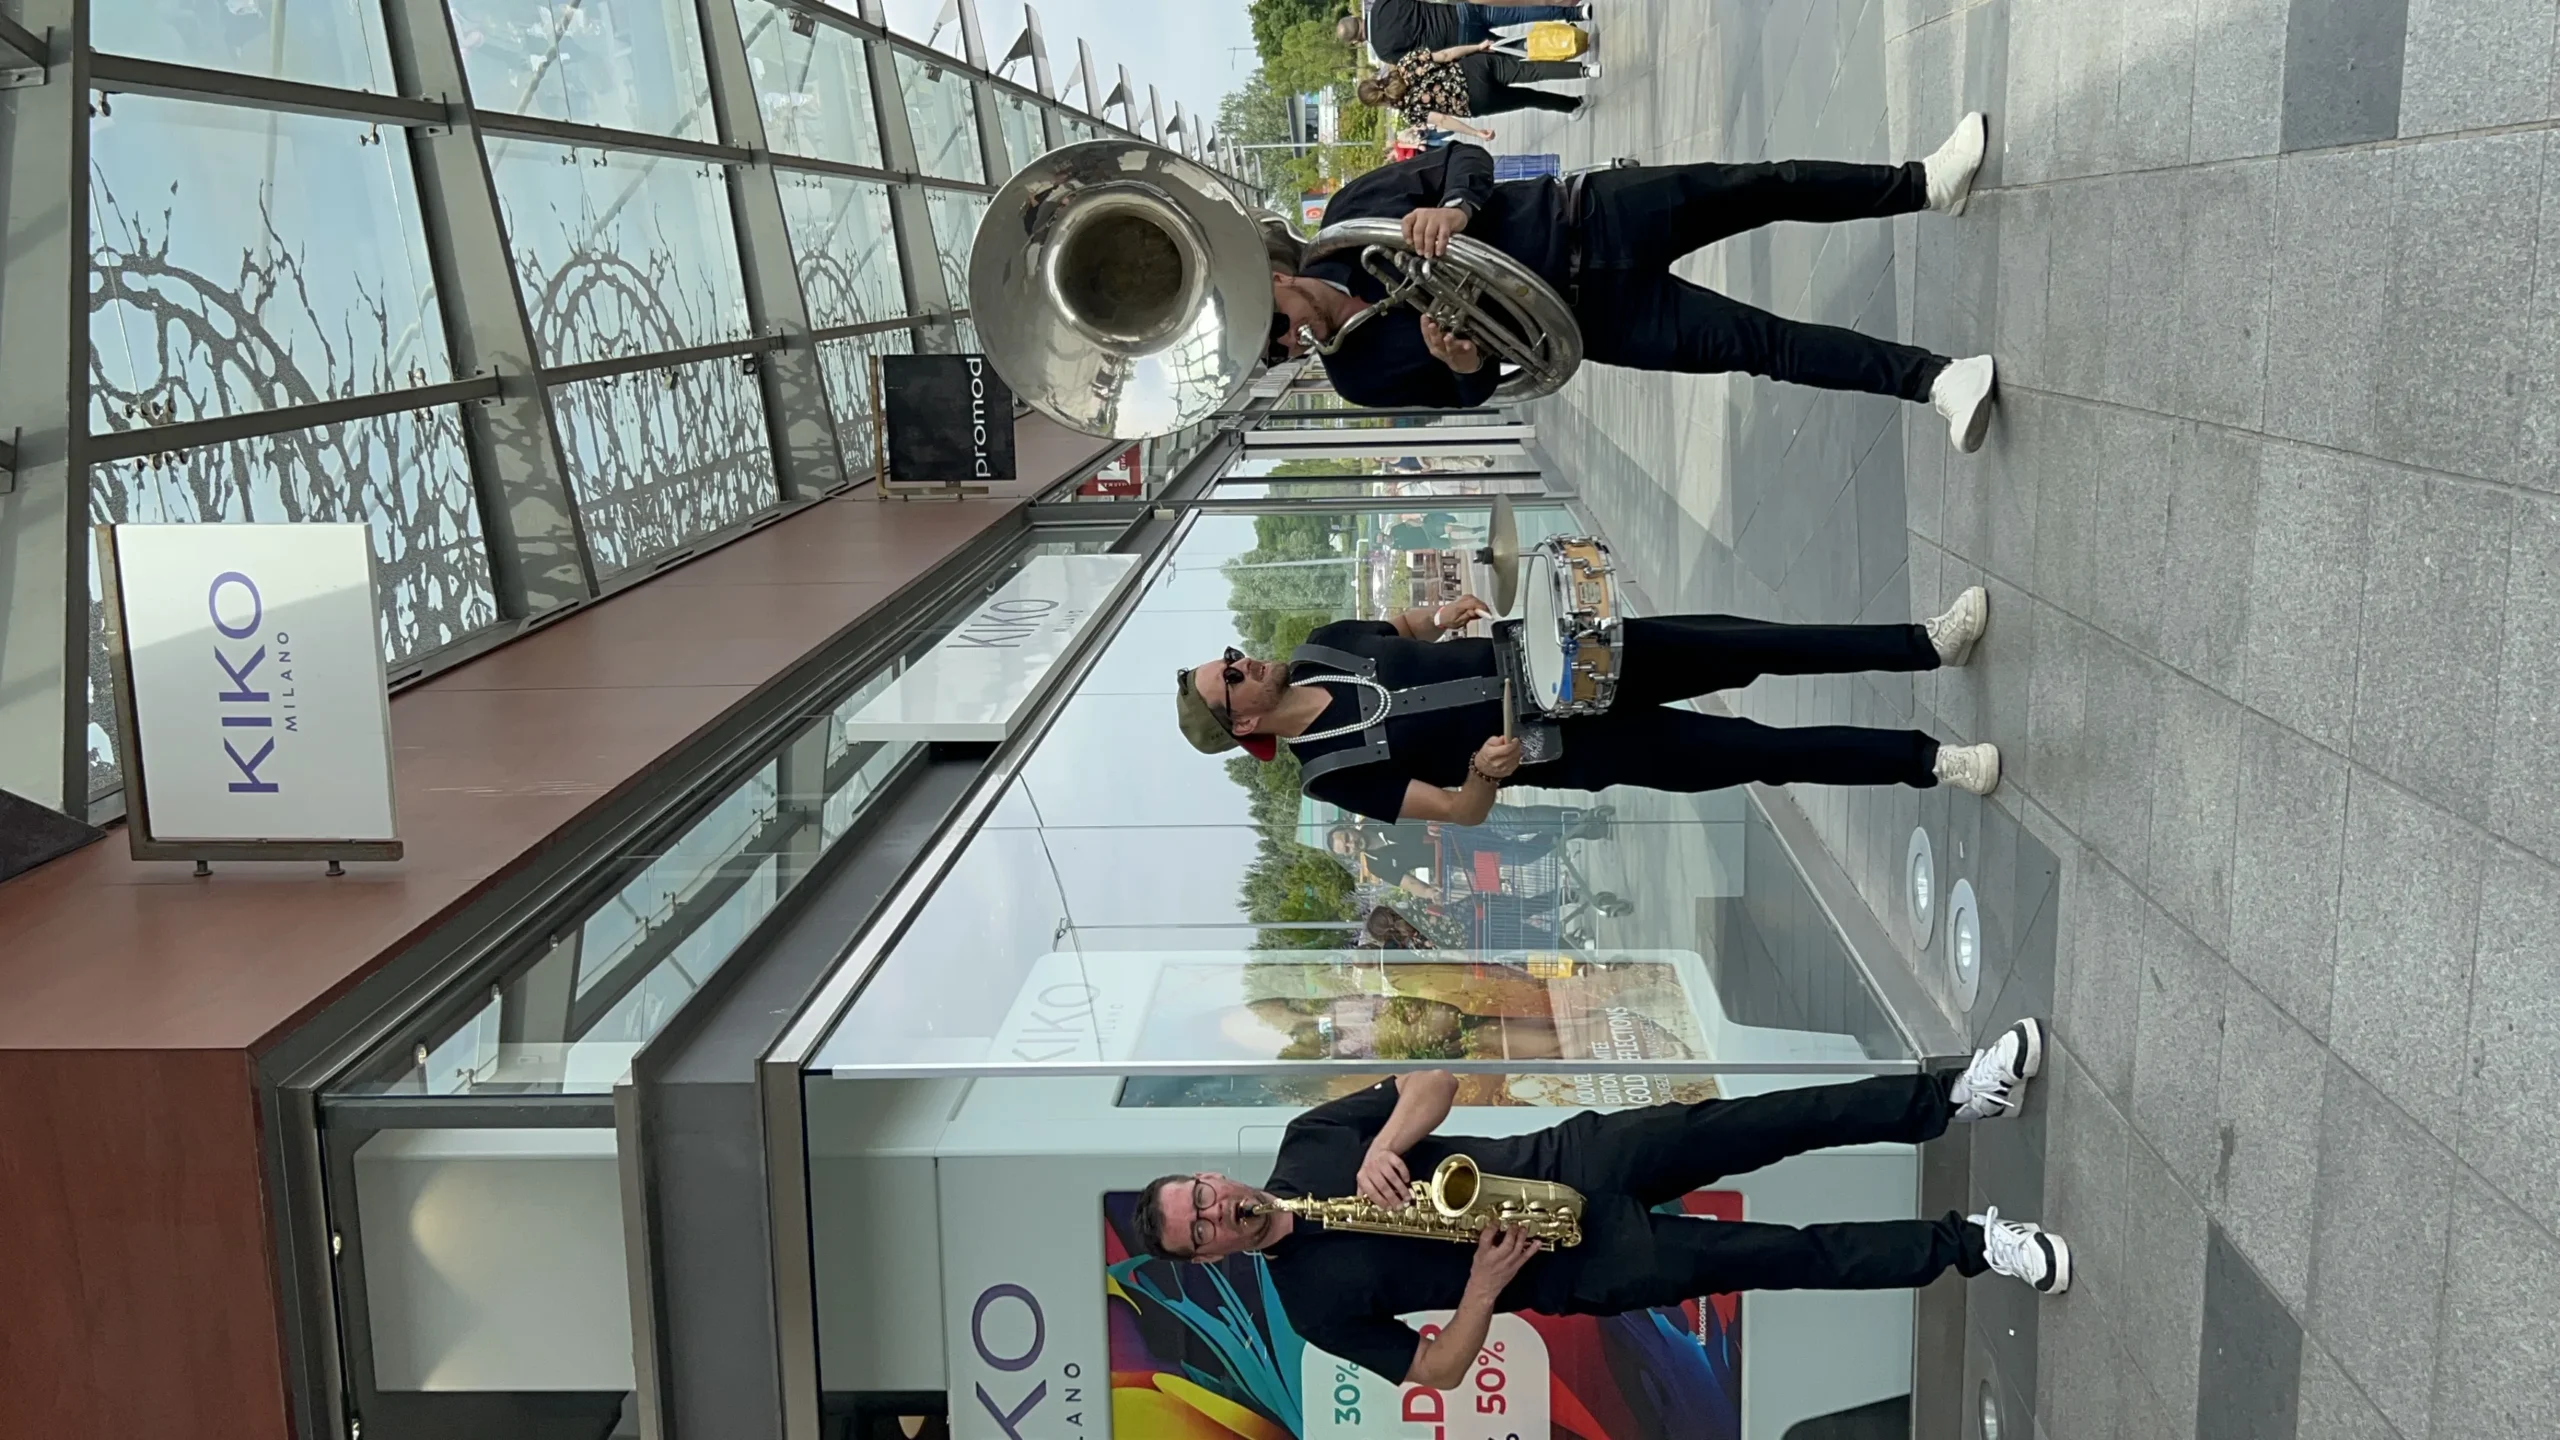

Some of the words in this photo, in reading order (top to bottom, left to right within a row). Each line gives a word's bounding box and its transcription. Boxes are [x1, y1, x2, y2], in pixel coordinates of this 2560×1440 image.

[966, 358, 992, 477] promod
[946, 599, 1059, 648] KIKO
[208, 571, 279, 793] KIKO
[276, 632, 298, 732] MILANO
[1605, 1006, 1642, 1061] EFLECTIONS
[1573, 1074, 1596, 1106] NOUVEL
[1622, 1074, 1653, 1104] GOLD
[971, 1283, 1047, 1440] KO
[1334, 1361, 1361, 1425] 30%
[1475, 1341, 1506, 1415] 50%
